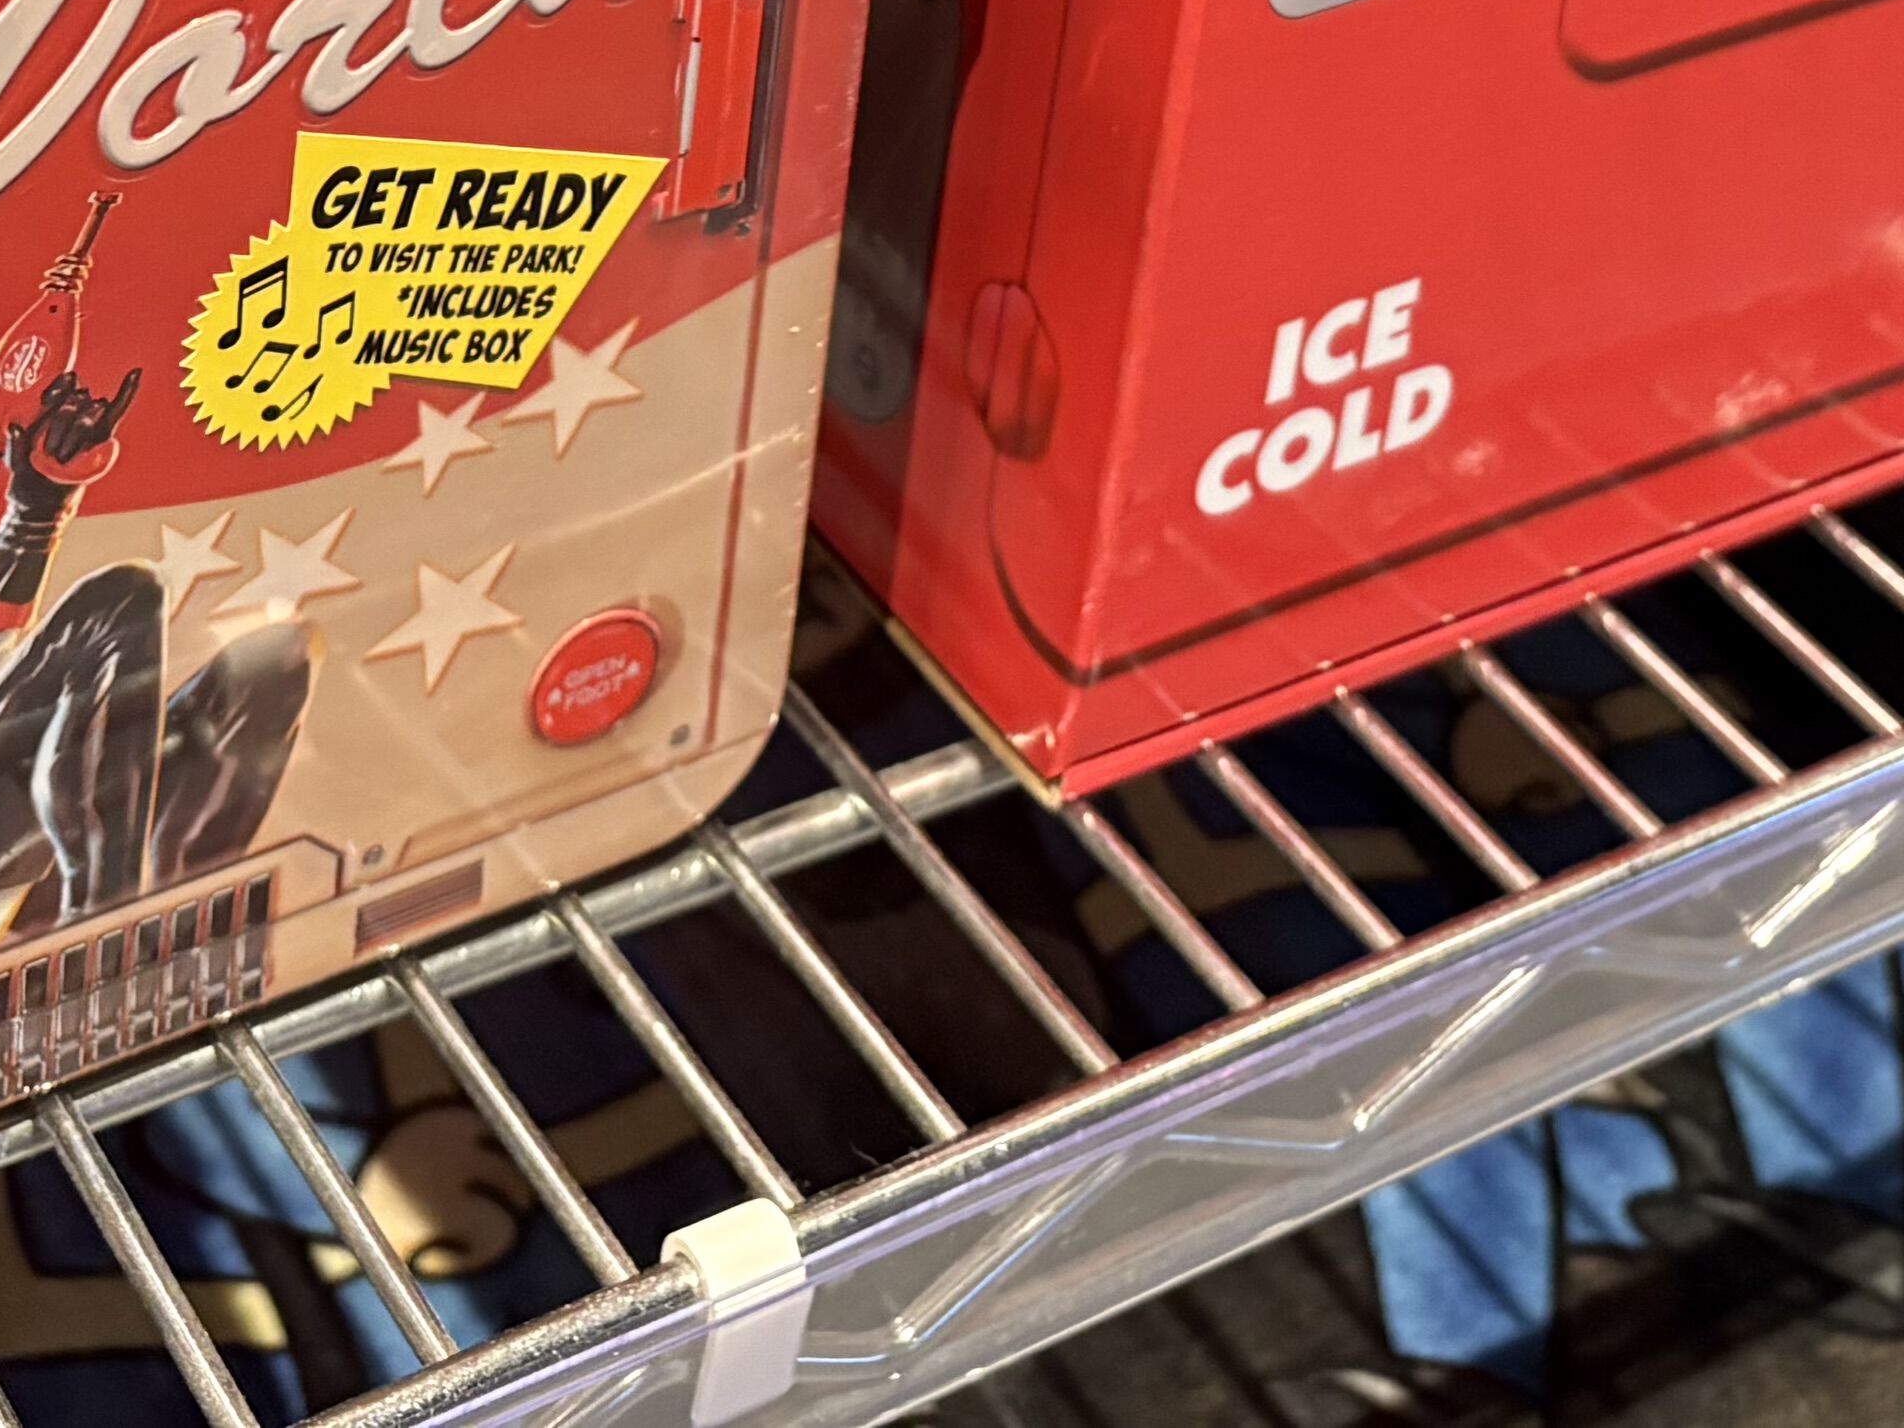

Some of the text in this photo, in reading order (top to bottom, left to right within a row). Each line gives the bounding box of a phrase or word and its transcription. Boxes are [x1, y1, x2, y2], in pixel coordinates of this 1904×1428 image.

[311, 165, 627, 233] GET READY
[324, 242, 584, 275] TO VISIT THE PARK!
[354, 328, 534, 366] MUSIC BOX
[1264, 276, 1422, 406] ICE
[1194, 363, 1454, 516] COLD
